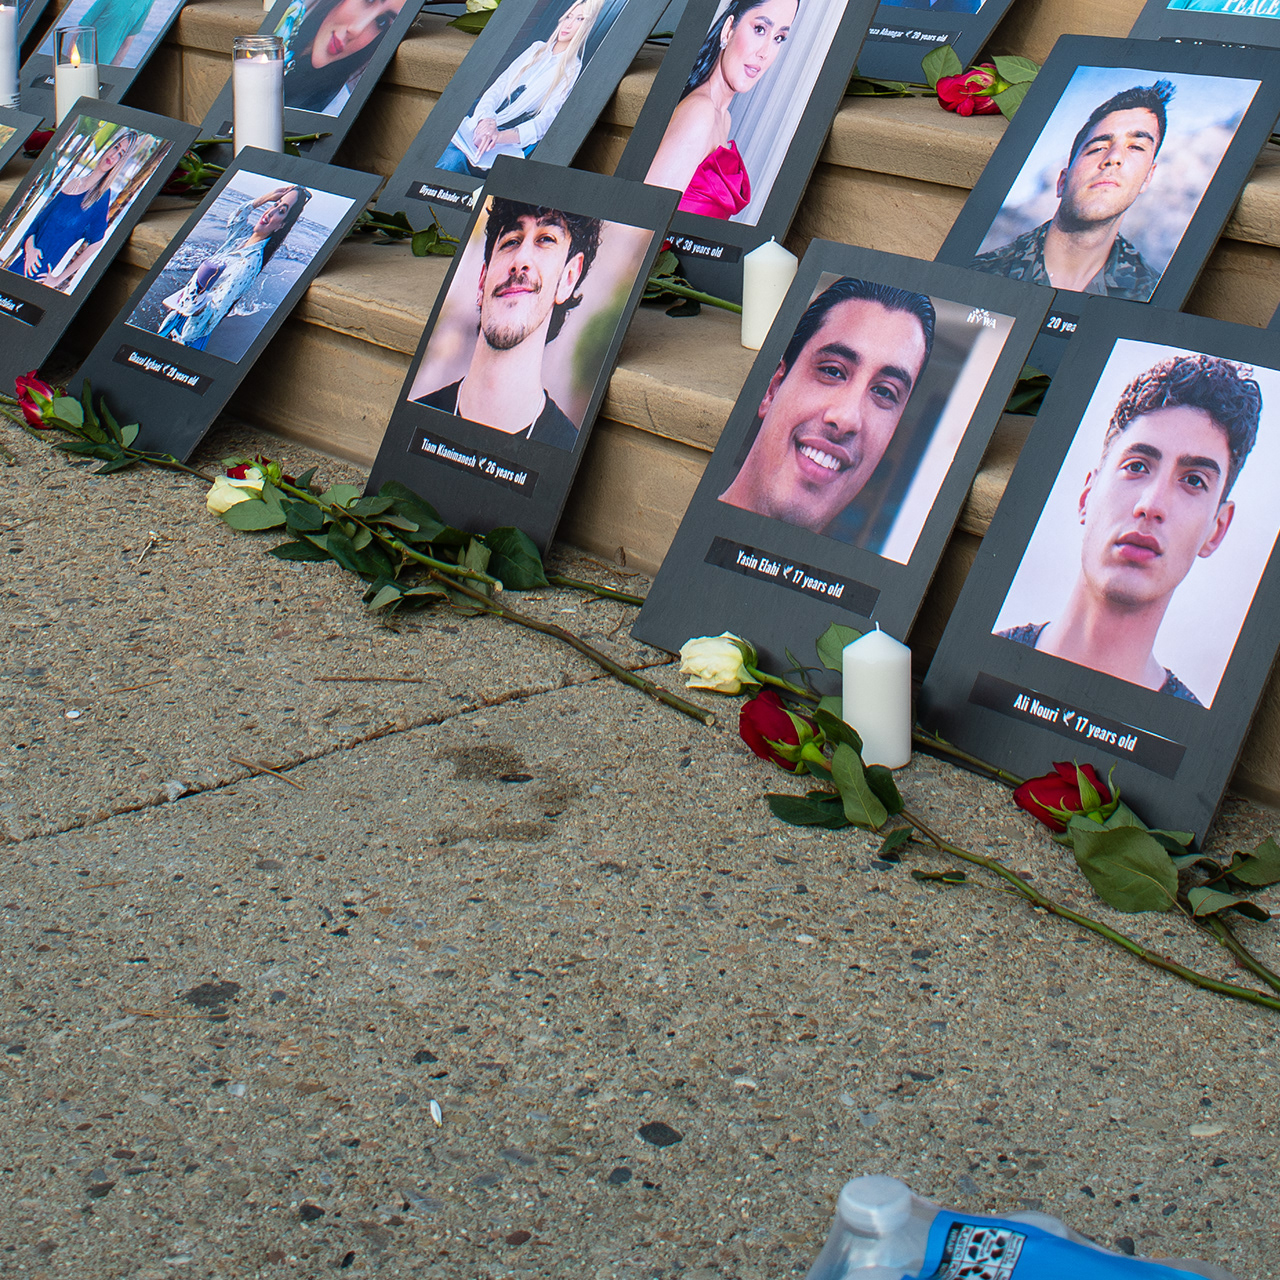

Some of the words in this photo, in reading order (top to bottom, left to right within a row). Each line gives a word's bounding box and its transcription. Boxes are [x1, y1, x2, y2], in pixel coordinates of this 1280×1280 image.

[936, 34, 949, 42] old
[682, 240, 693, 251] 38
[692, 244, 711, 256] years
[710, 246, 724, 259] old
[1046, 316, 1062, 329] 20
[1059, 321, 1077, 333] yea
[172, 371, 189, 383] years
[187, 376, 200, 386] old
[421, 437, 436, 454] Tiam
[485, 461, 497, 474] 26
[495, 466, 514, 482] years
[513, 473, 527, 486] old
[736, 550, 758, 568] Yasin
[758, 558, 780, 577] Elahi
[792, 569, 805, 584] 17
[801, 576, 828, 594] years
[827, 582, 845, 599] old
[1013, 693, 1030, 711] Ali
[1030, 699, 1060, 723] Nouri
[1074, 715, 1089, 733] 17
[1086, 721, 1118, 745] years
[1118, 733, 1138, 752] old
